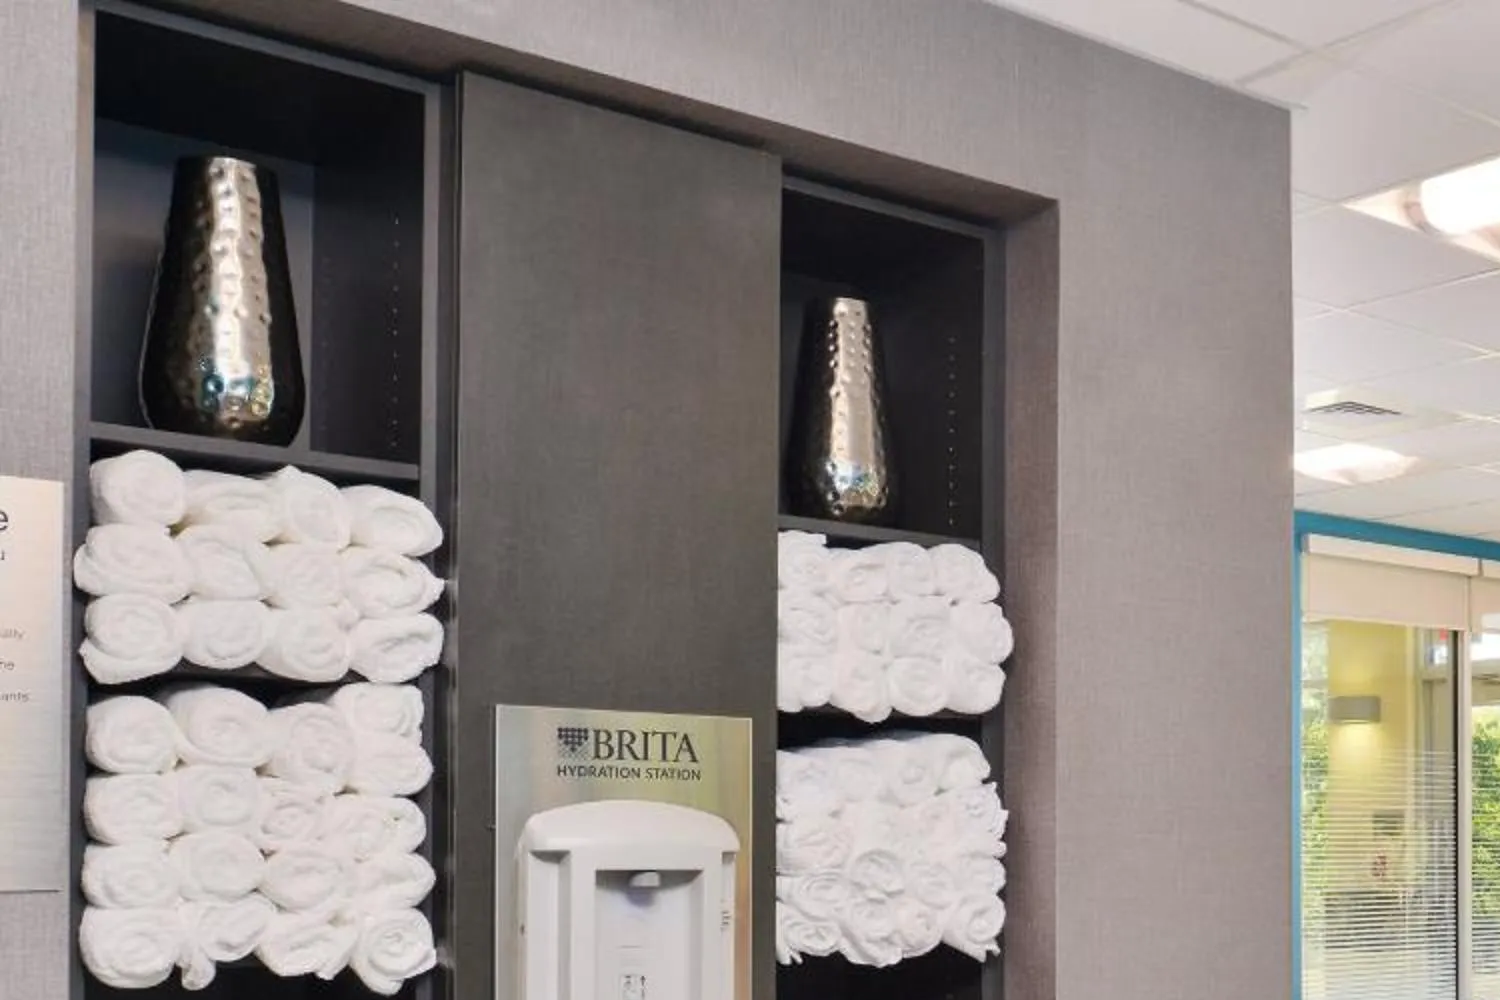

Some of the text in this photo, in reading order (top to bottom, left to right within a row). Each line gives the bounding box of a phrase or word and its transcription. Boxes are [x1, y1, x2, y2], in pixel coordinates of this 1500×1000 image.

[592, 729, 699, 763] BRITA
[557, 764, 702, 782] HYDRATION STATION
